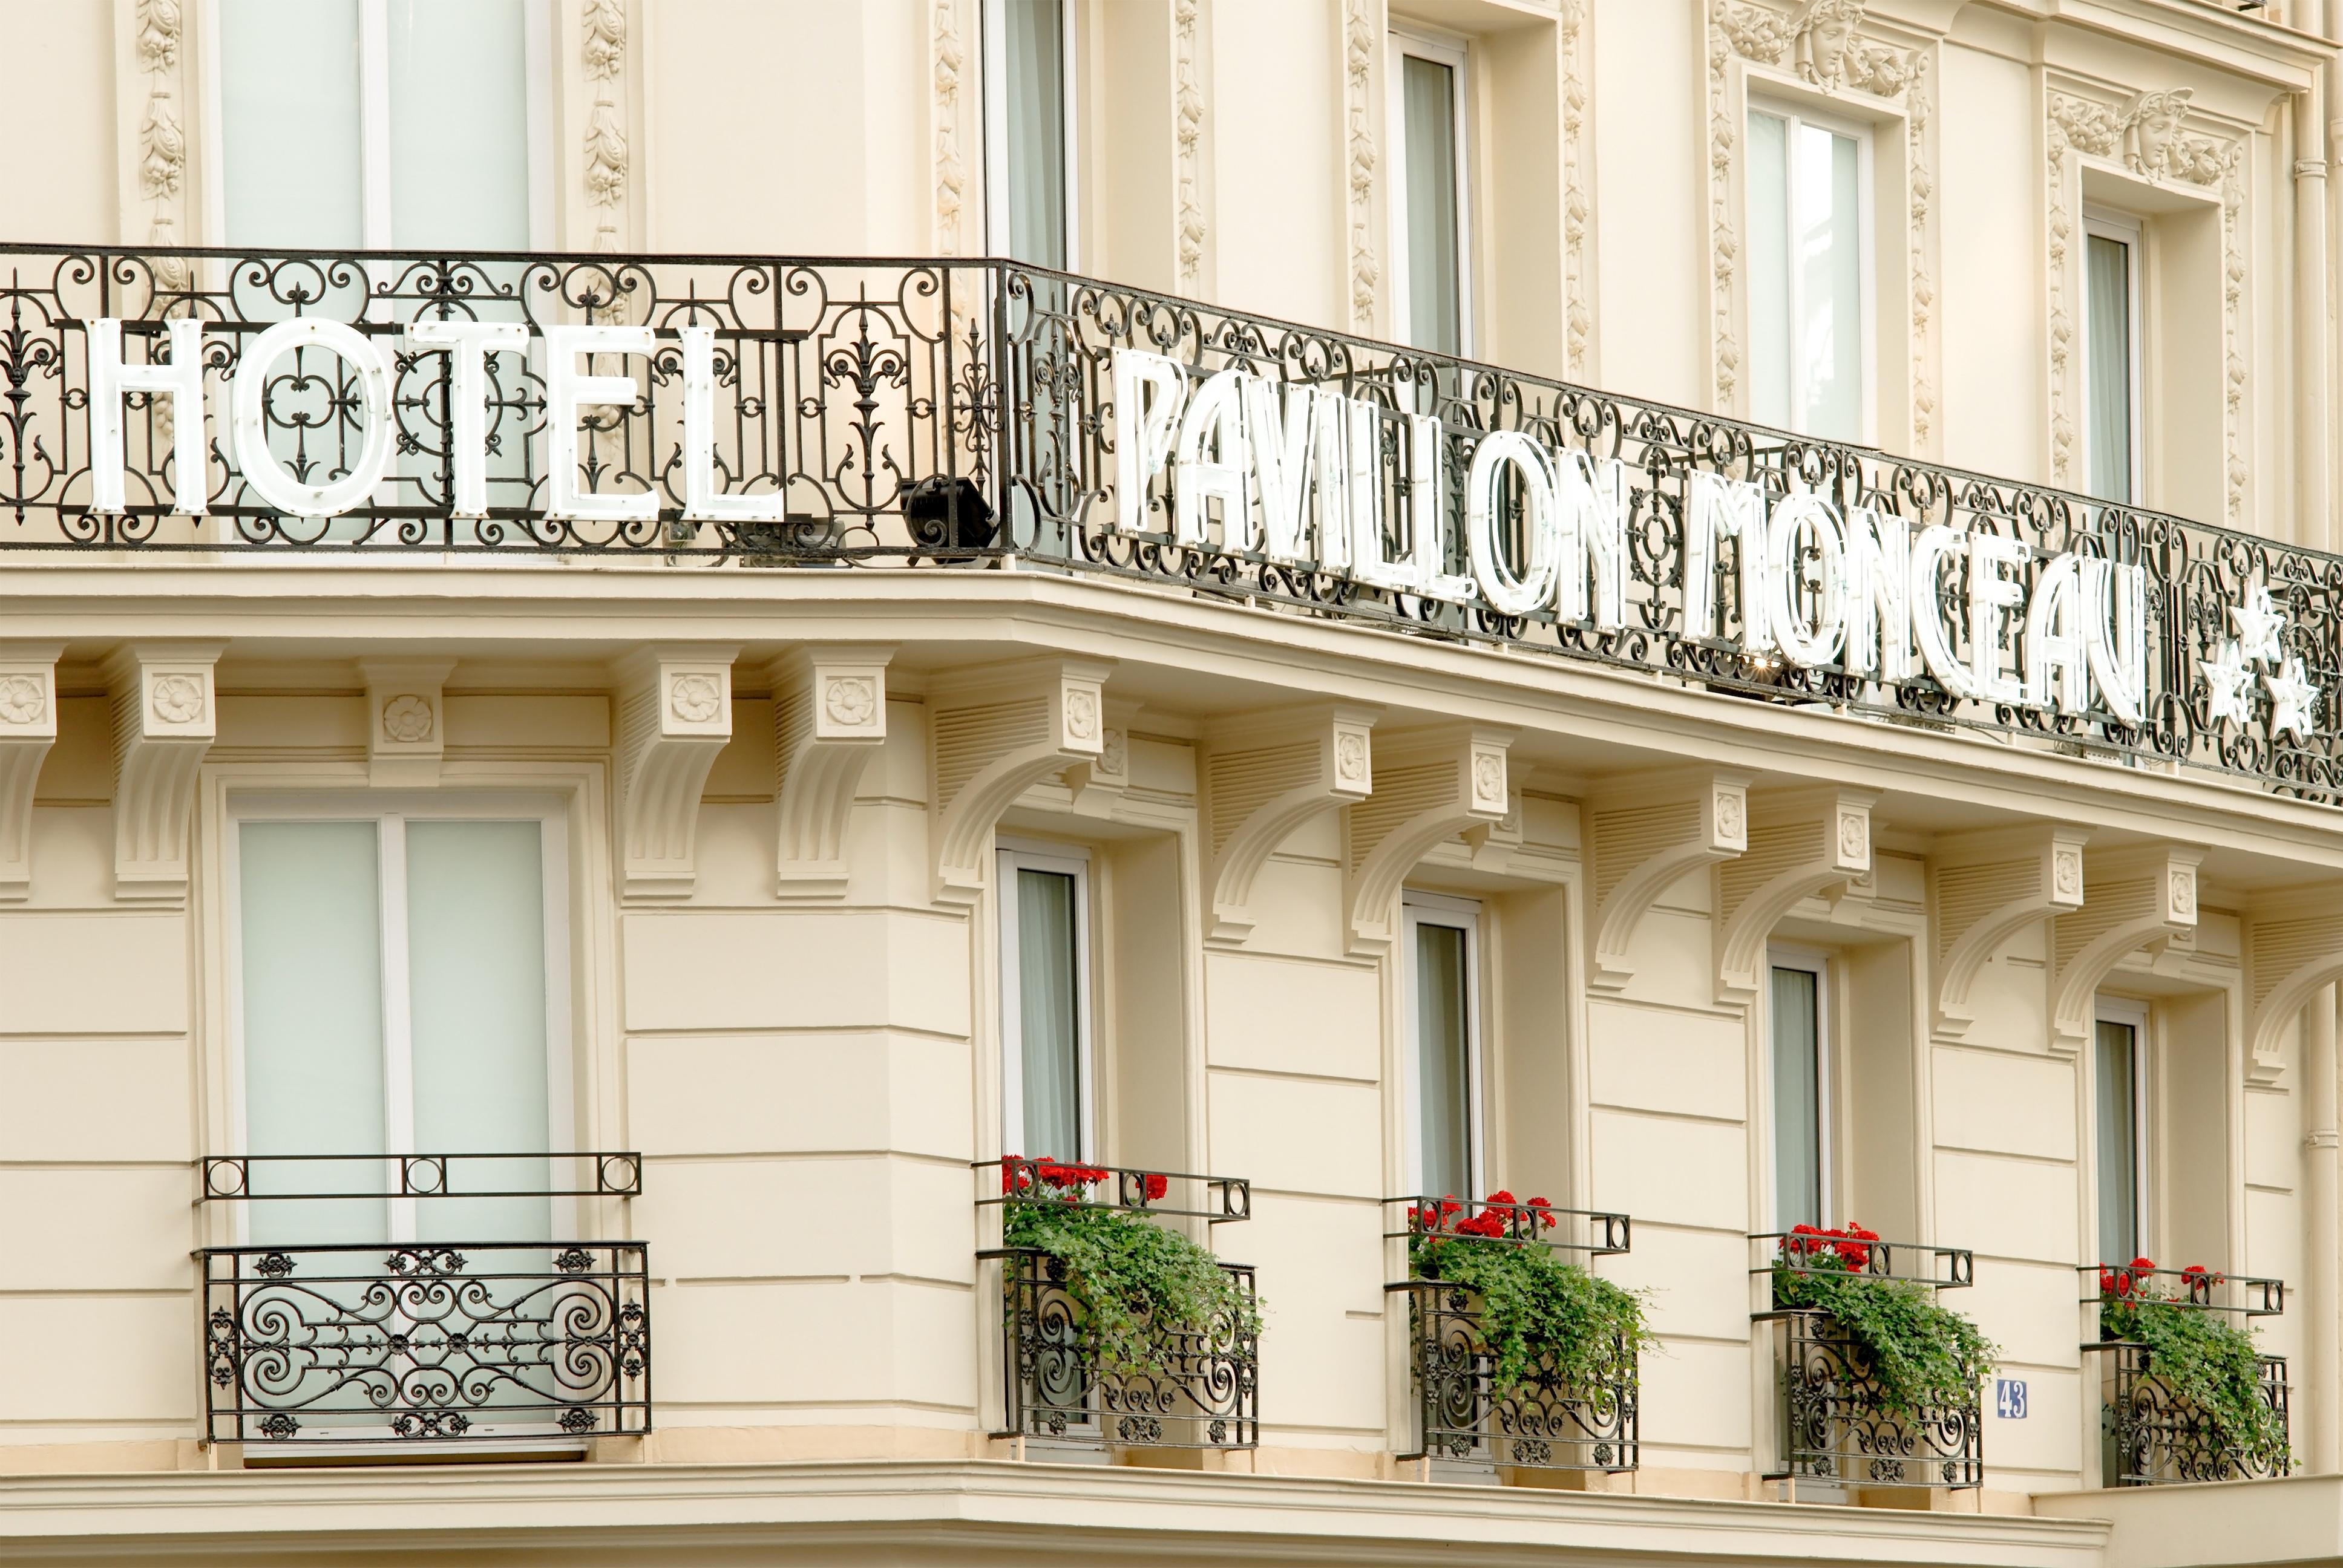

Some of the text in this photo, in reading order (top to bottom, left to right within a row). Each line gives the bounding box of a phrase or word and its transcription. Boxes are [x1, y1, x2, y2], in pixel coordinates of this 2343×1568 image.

[84, 316, 785, 522] HOTEL
[1111, 346, 2146, 730] PAVILLON MONCEAU
[1999, 1380, 2025, 1418] 43
